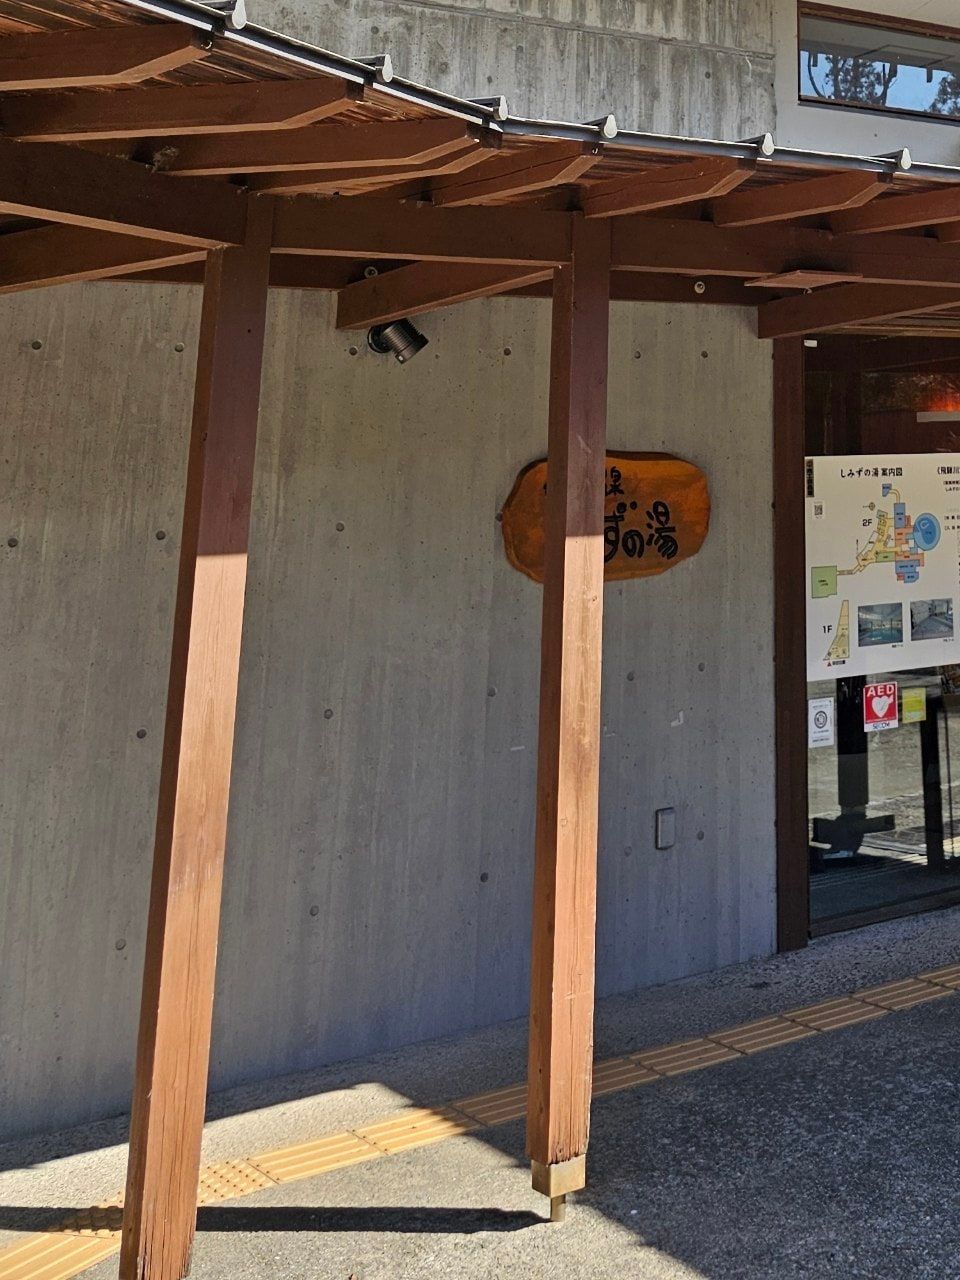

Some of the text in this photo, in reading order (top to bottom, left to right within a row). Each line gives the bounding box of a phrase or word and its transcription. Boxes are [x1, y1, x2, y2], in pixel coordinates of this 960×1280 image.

[862, 519, 873, 527] 2F
[822, 625, 833, 634] 1F
[866, 684, 895, 698] AED
